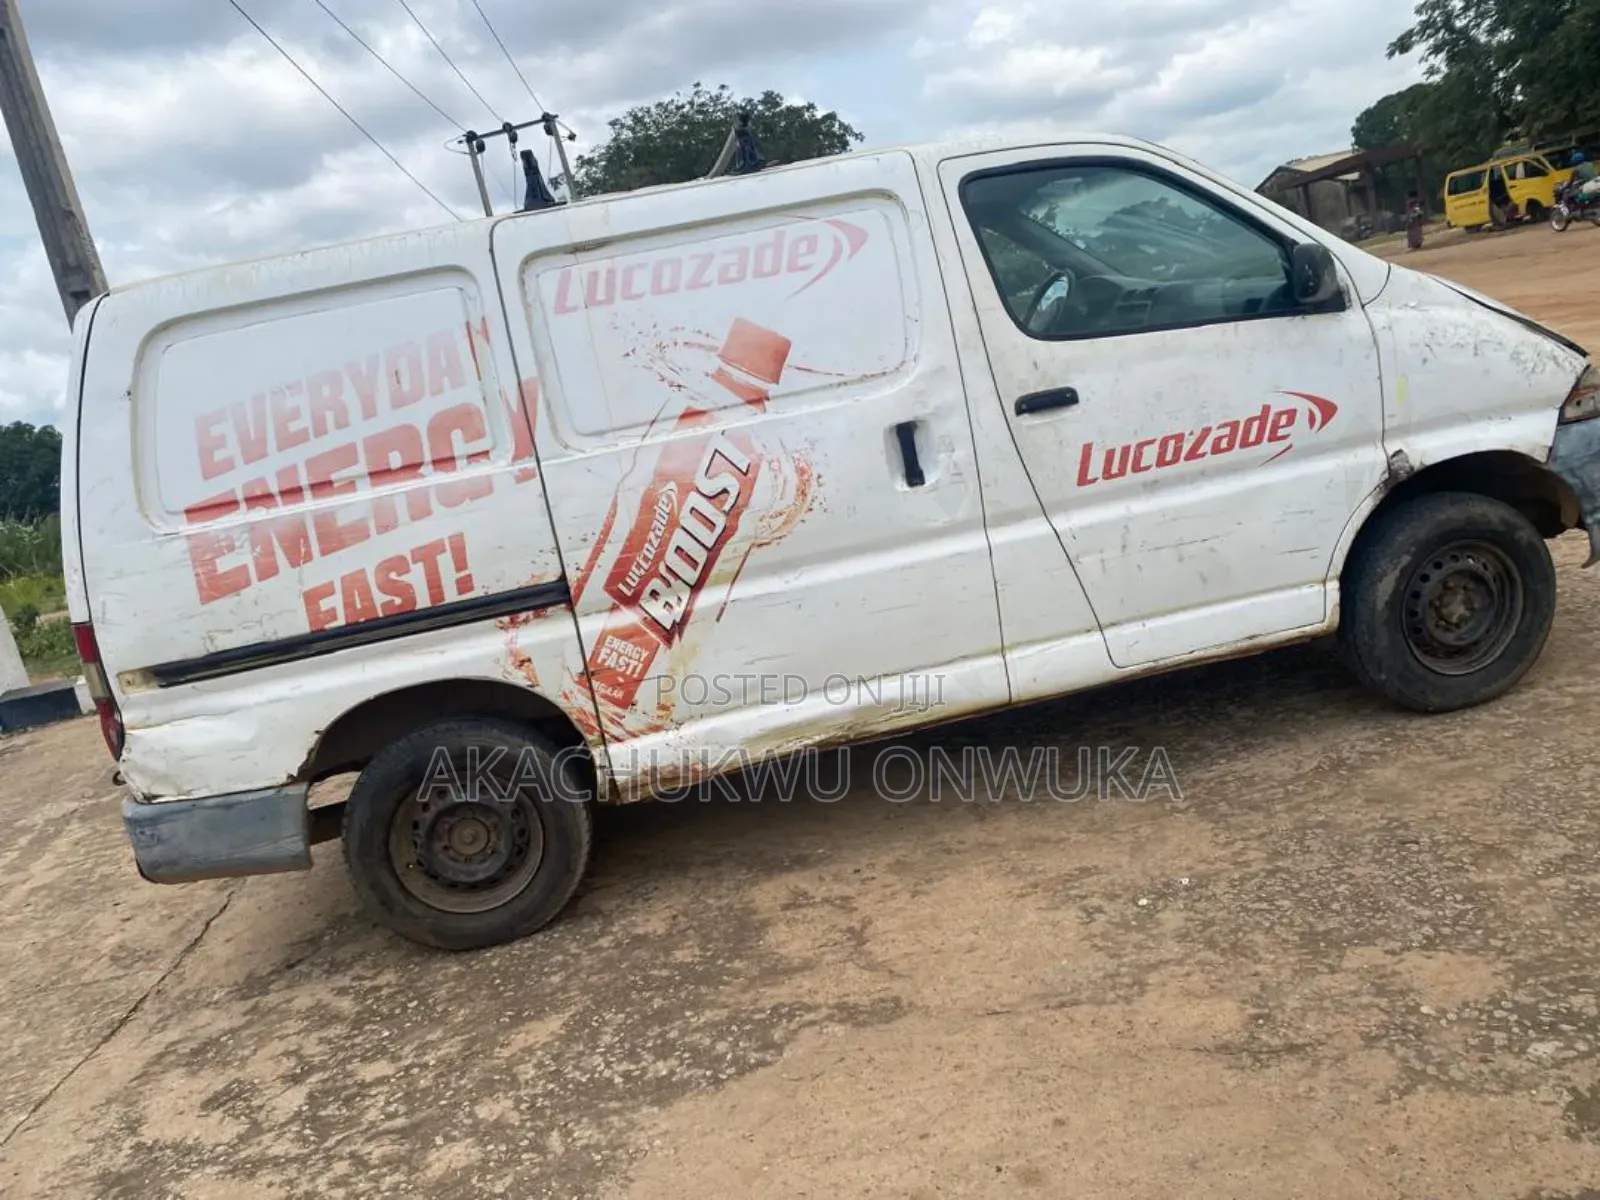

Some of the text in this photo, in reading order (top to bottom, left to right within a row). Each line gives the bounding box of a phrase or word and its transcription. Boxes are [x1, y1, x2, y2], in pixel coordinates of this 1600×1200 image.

[553, 229, 820, 316] Lucozade
[1076, 403, 1298, 487] Lucozade
[639, 431, 751, 631] BOOST
[302, 532, 475, 633] FAST!
[596, 646, 644, 679] FAST!
[602, 635, 650, 662] ENERGY
